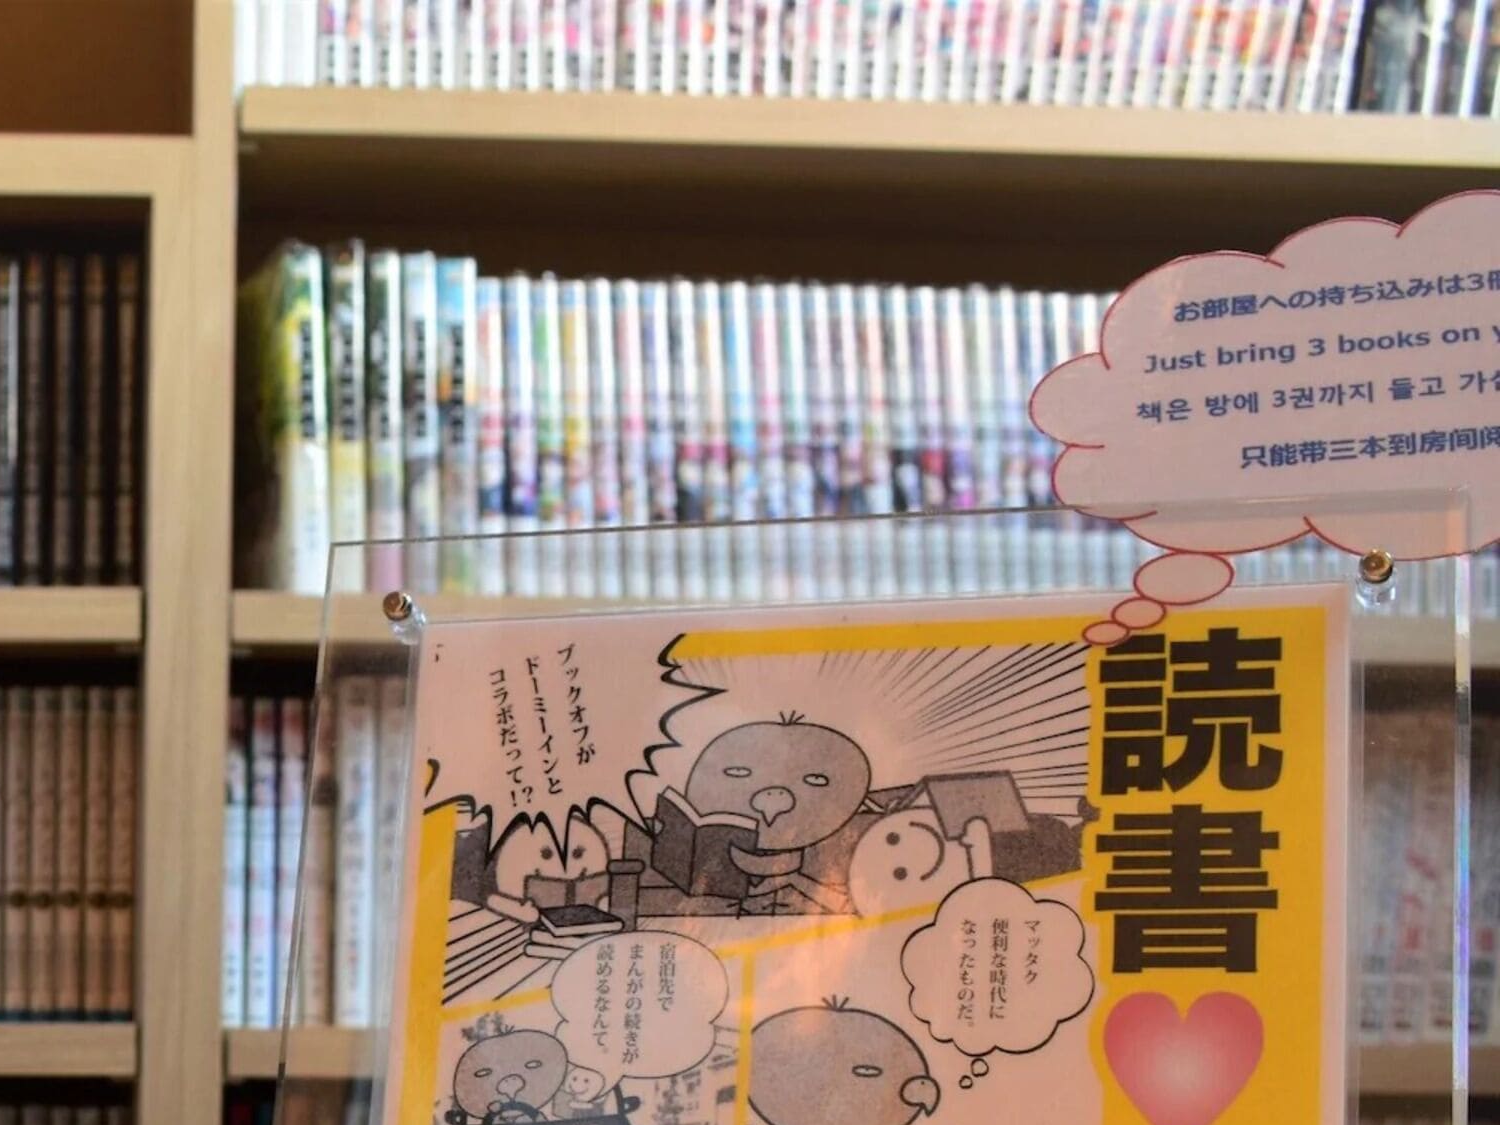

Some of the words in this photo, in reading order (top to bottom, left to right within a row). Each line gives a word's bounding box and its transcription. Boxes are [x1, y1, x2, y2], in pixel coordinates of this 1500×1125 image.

[1136, 399, 1192, 423] 책은
[1205, 391, 1260, 417] 방에
[1272, 382, 1374, 410] 3권까지
[1388, 376, 1446, 401] 들고
[1143, 351, 1206, 374] Just
[1217, 343, 1295, 368] bring
[1308, 338, 1326, 356] 3
[1338, 328, 1430, 355] books
[1441, 325, 1480, 345] on
[524, 656, 563, 794] ドーミーインと
[558, 643, 596, 765] ブックオフが
[989, 918, 1009, 1019] 便利な時代に
